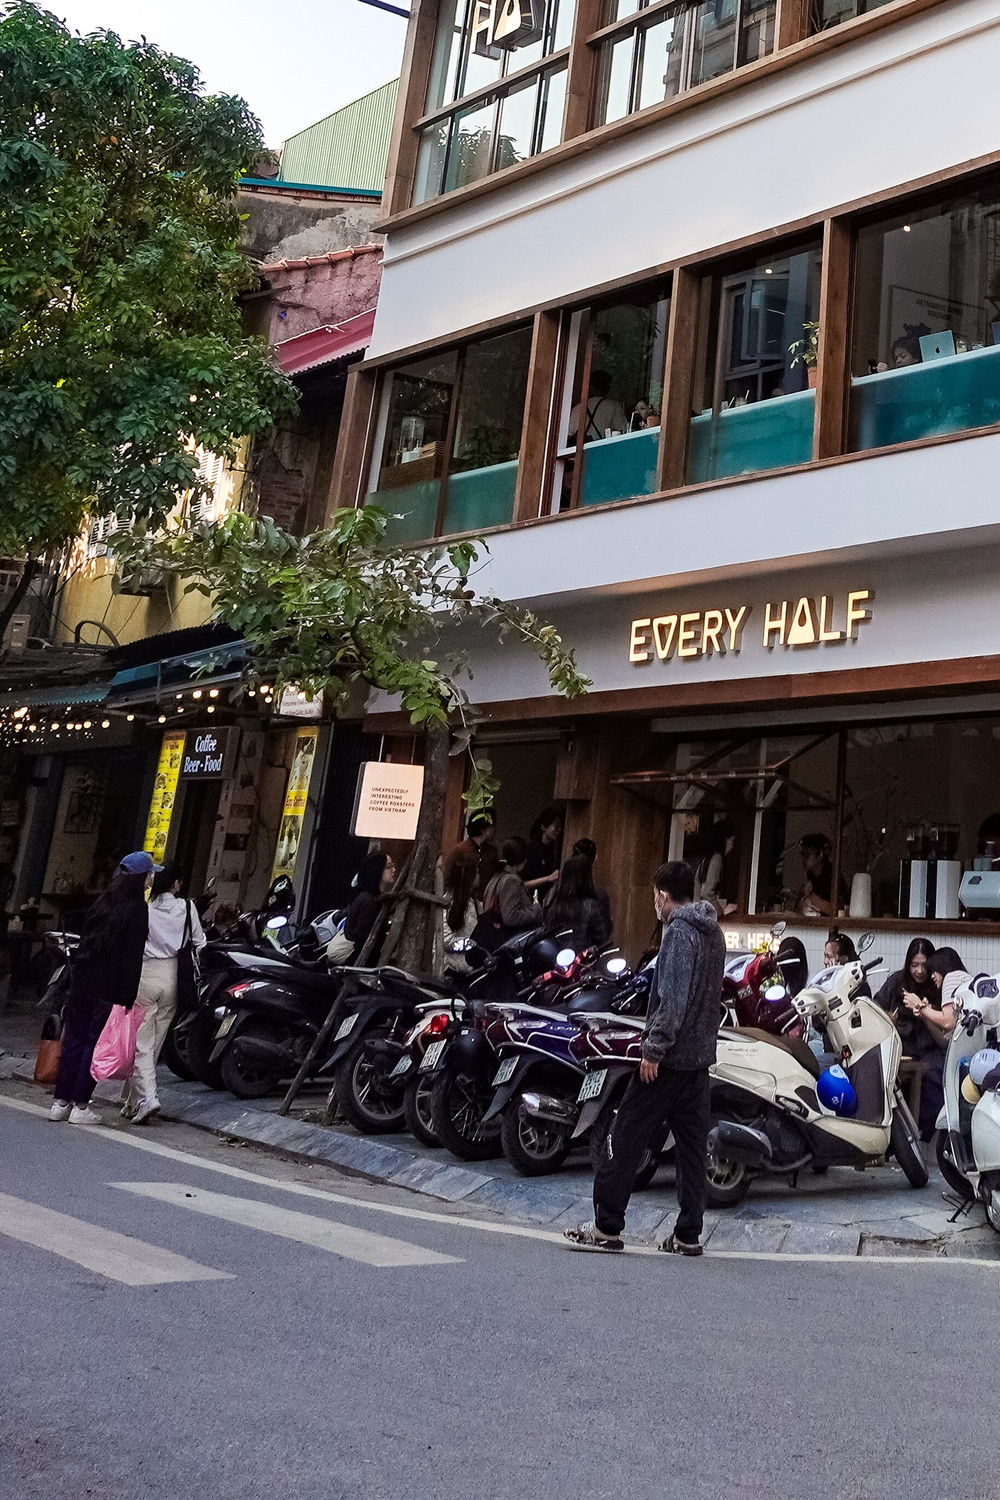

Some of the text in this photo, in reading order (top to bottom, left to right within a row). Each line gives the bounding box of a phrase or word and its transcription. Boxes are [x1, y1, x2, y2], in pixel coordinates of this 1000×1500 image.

[629, 590, 869, 662] EVERY HALF
[195, 734, 217, 752] Coffee
[183, 756, 200, 772] Beer
[203, 753, 223, 772] Food
